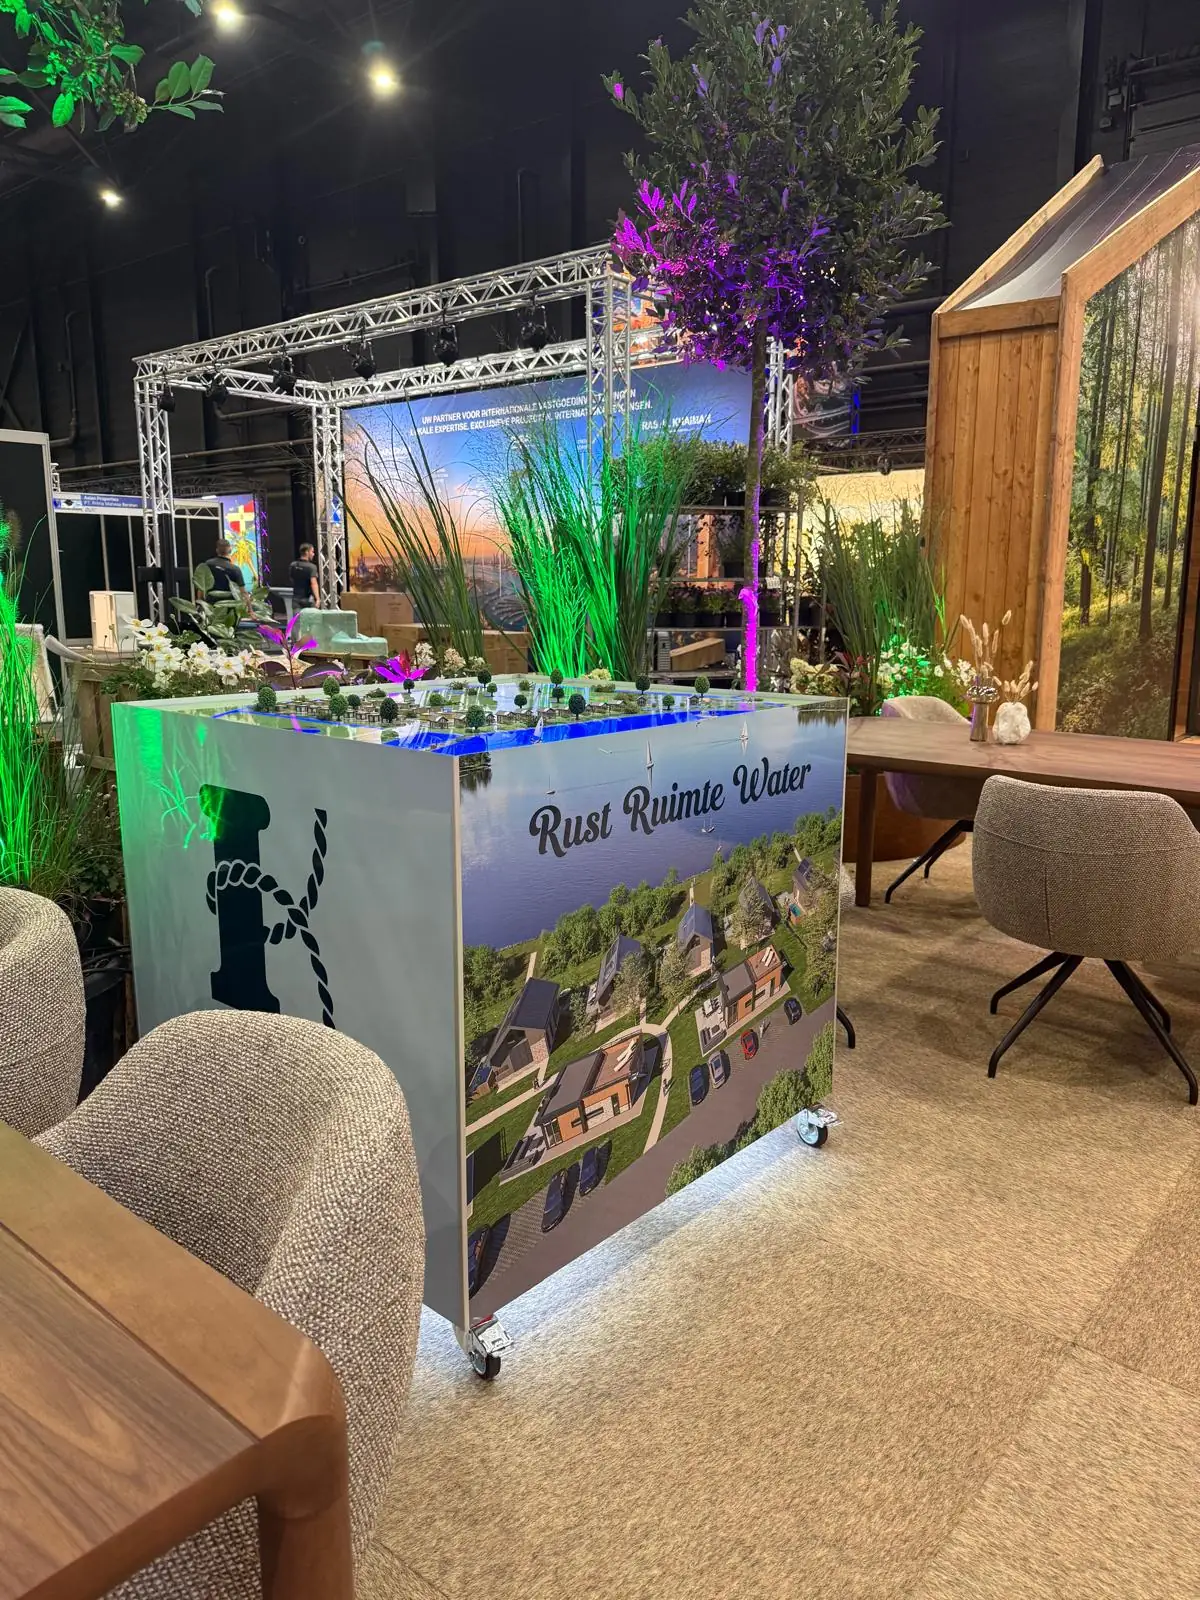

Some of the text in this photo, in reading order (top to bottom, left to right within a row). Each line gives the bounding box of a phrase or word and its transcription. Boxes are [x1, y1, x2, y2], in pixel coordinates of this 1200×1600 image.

[433, 412, 462, 424] PARTNER
[461, 409, 481, 419] VOOR
[529, 756, 812, 858] Rust Ruimte Water
